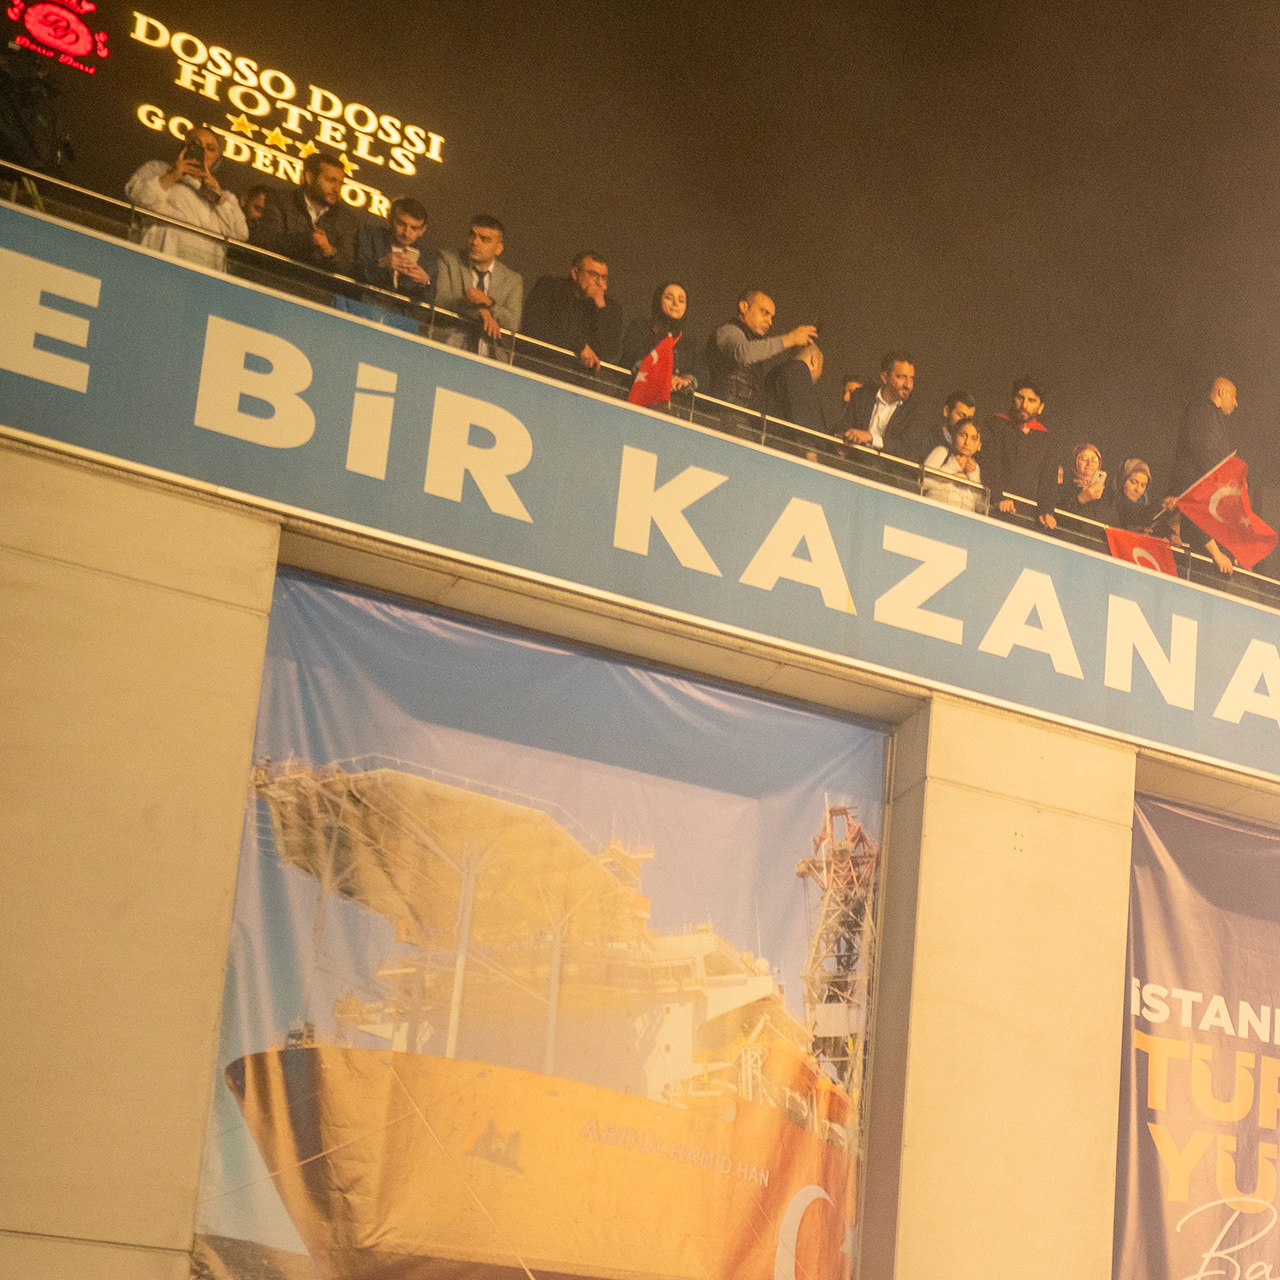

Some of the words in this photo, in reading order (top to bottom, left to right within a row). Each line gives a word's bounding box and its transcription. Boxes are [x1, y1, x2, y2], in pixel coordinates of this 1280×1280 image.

[130, 11, 297, 101] DOSSO
[306, 84, 446, 164] DOSSI
[136, 103, 303, 186] GODEN
[174, 58, 416, 177] HOTELS
